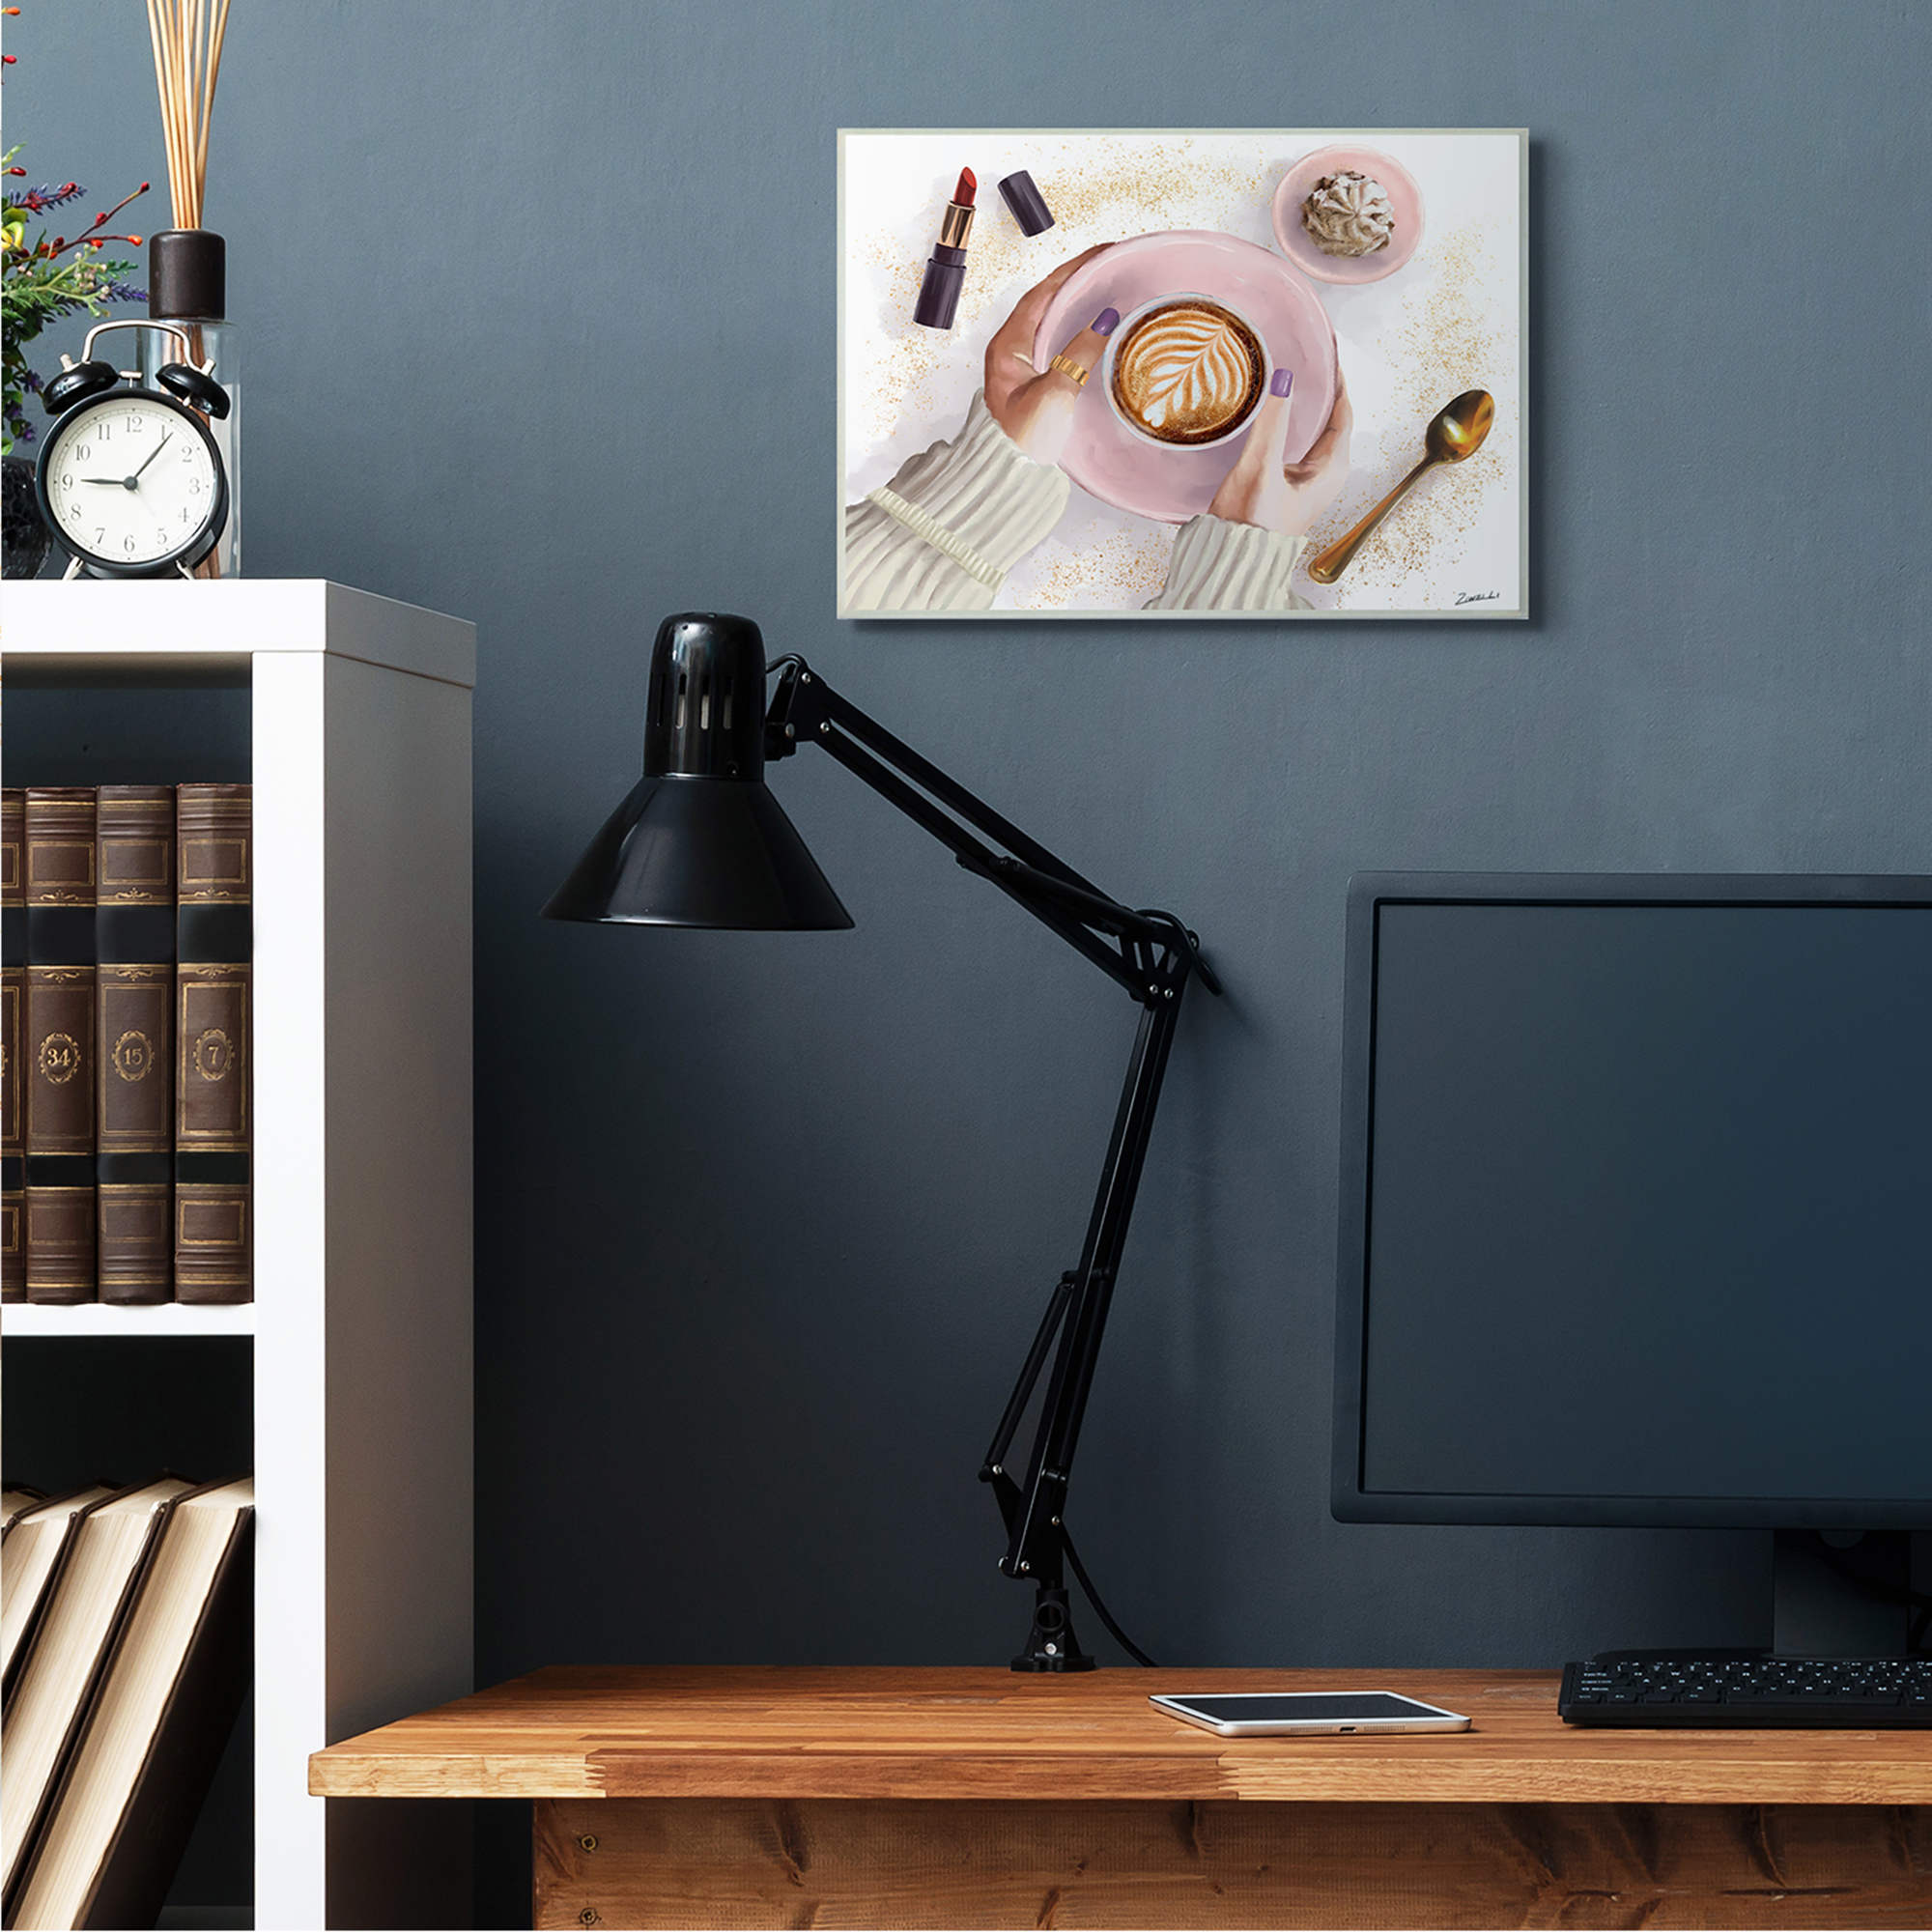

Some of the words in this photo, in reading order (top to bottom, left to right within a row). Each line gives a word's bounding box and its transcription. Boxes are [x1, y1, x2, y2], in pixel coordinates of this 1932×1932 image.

[98, 424, 111, 440] 11
[127, 416, 143, 433] 12
[161, 425, 166, 440] 1
[75, 444, 91, 461] 10
[182, 446, 192, 463] 2
[62, 473, 73, 492] 9
[189, 478, 200, 495] 3
[70, 503, 82, 521] 8
[178, 507, 190, 523] 4
[95, 527, 105, 544] 7
[123, 534, 135, 553] 6
[157, 528, 167, 545] 5
[47, 1047, 71, 1066] 34
[124, 1047, 144, 1065] 15
[208, 1046, 219, 1065] 7
